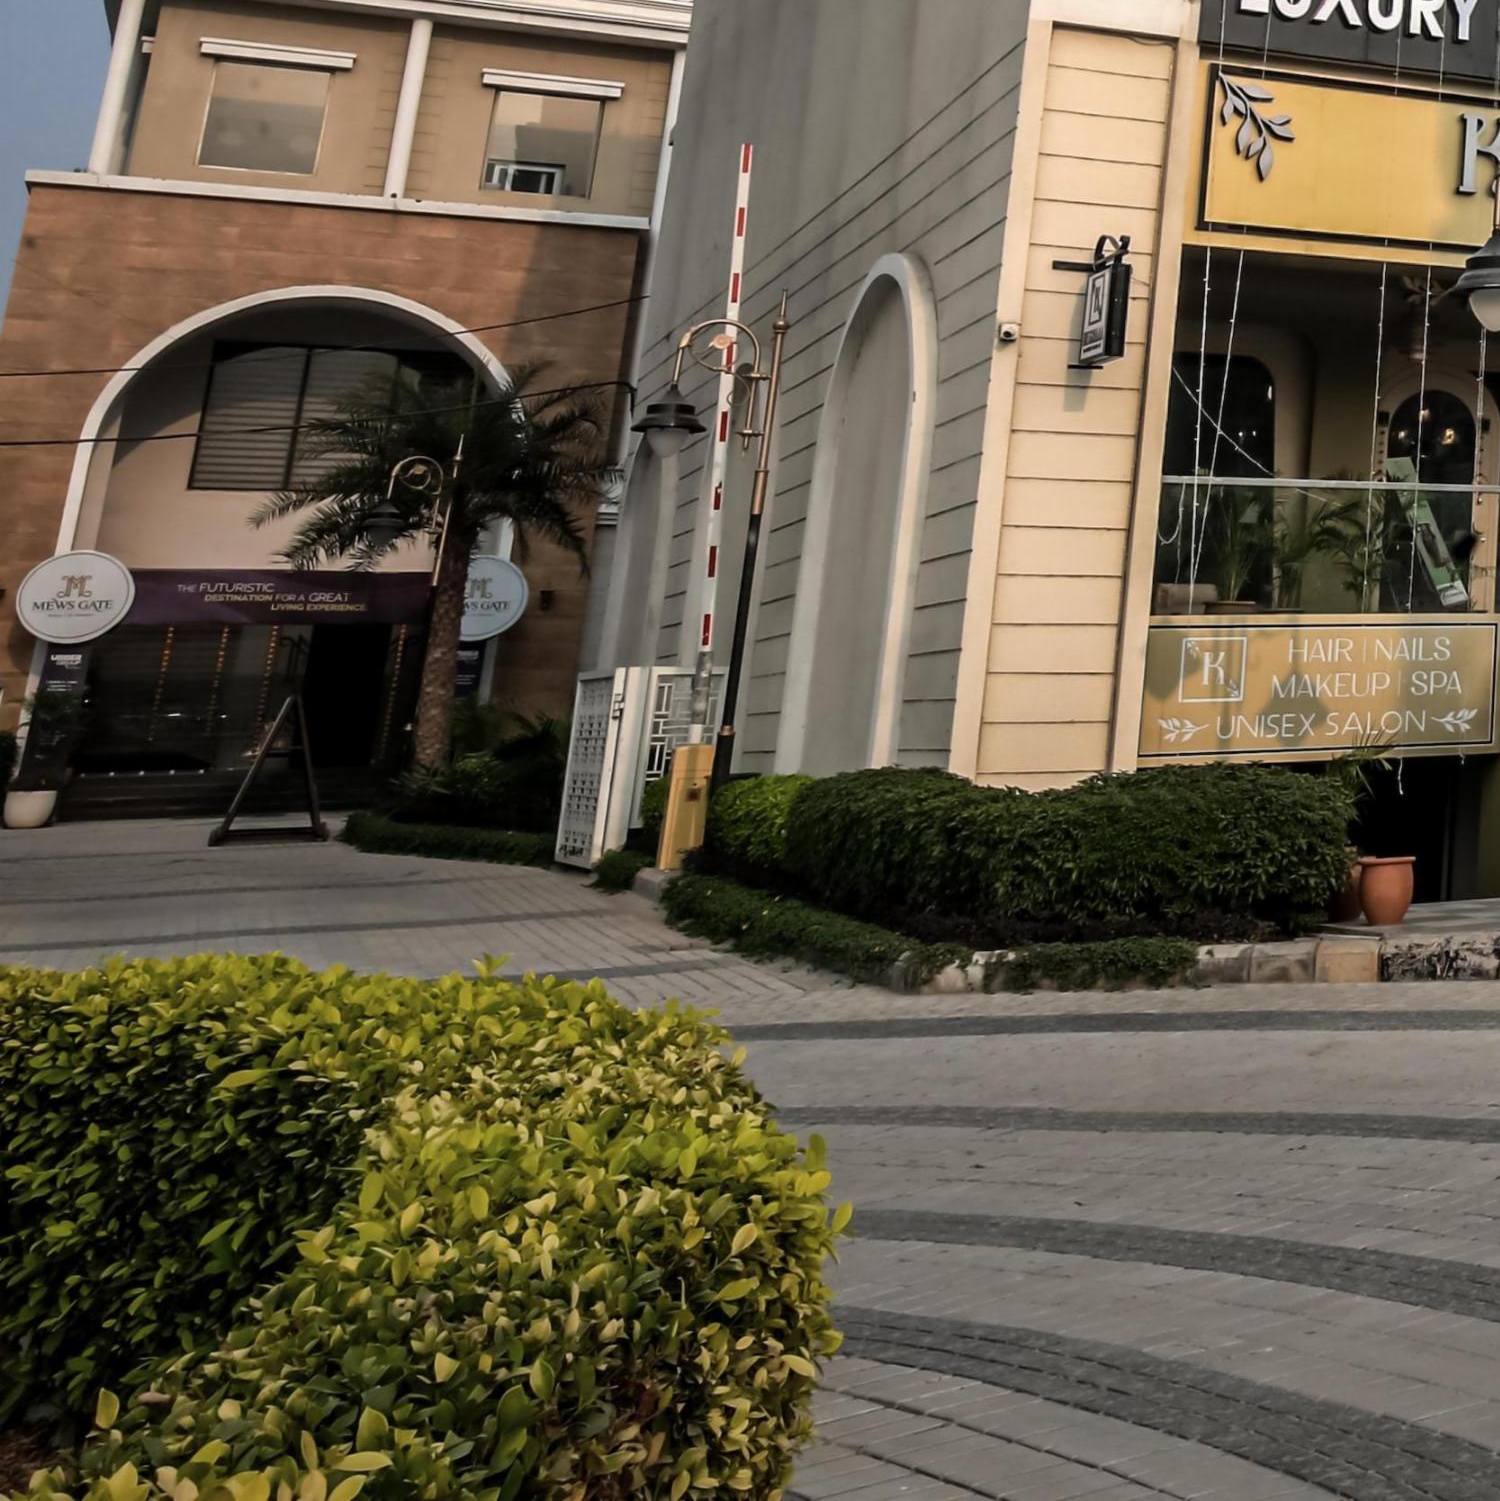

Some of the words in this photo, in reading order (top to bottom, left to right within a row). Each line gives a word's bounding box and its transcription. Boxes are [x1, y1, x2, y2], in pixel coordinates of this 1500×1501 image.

[176, 583, 197, 593] THE
[199, 582, 275, 593] FUTURISTIC
[204, 593, 273, 602] DESTINATION
[275, 593, 296, 602] FOR
[308, 592, 350, 603] GREAT
[32, 598, 76, 612] MEWS
[78, 599, 114, 613] GATE
[271, 602, 305, 611] LIVING
[1287, 637, 1355, 663] HAIR
[1373, 636, 1452, 663] NAILS
[1271, 671, 1391, 699] MAKEUP
[1410, 670, 1463, 696] SPA
[1215, 712, 1317, 740] UNISEX
[1325, 709, 1427, 736] SALON
